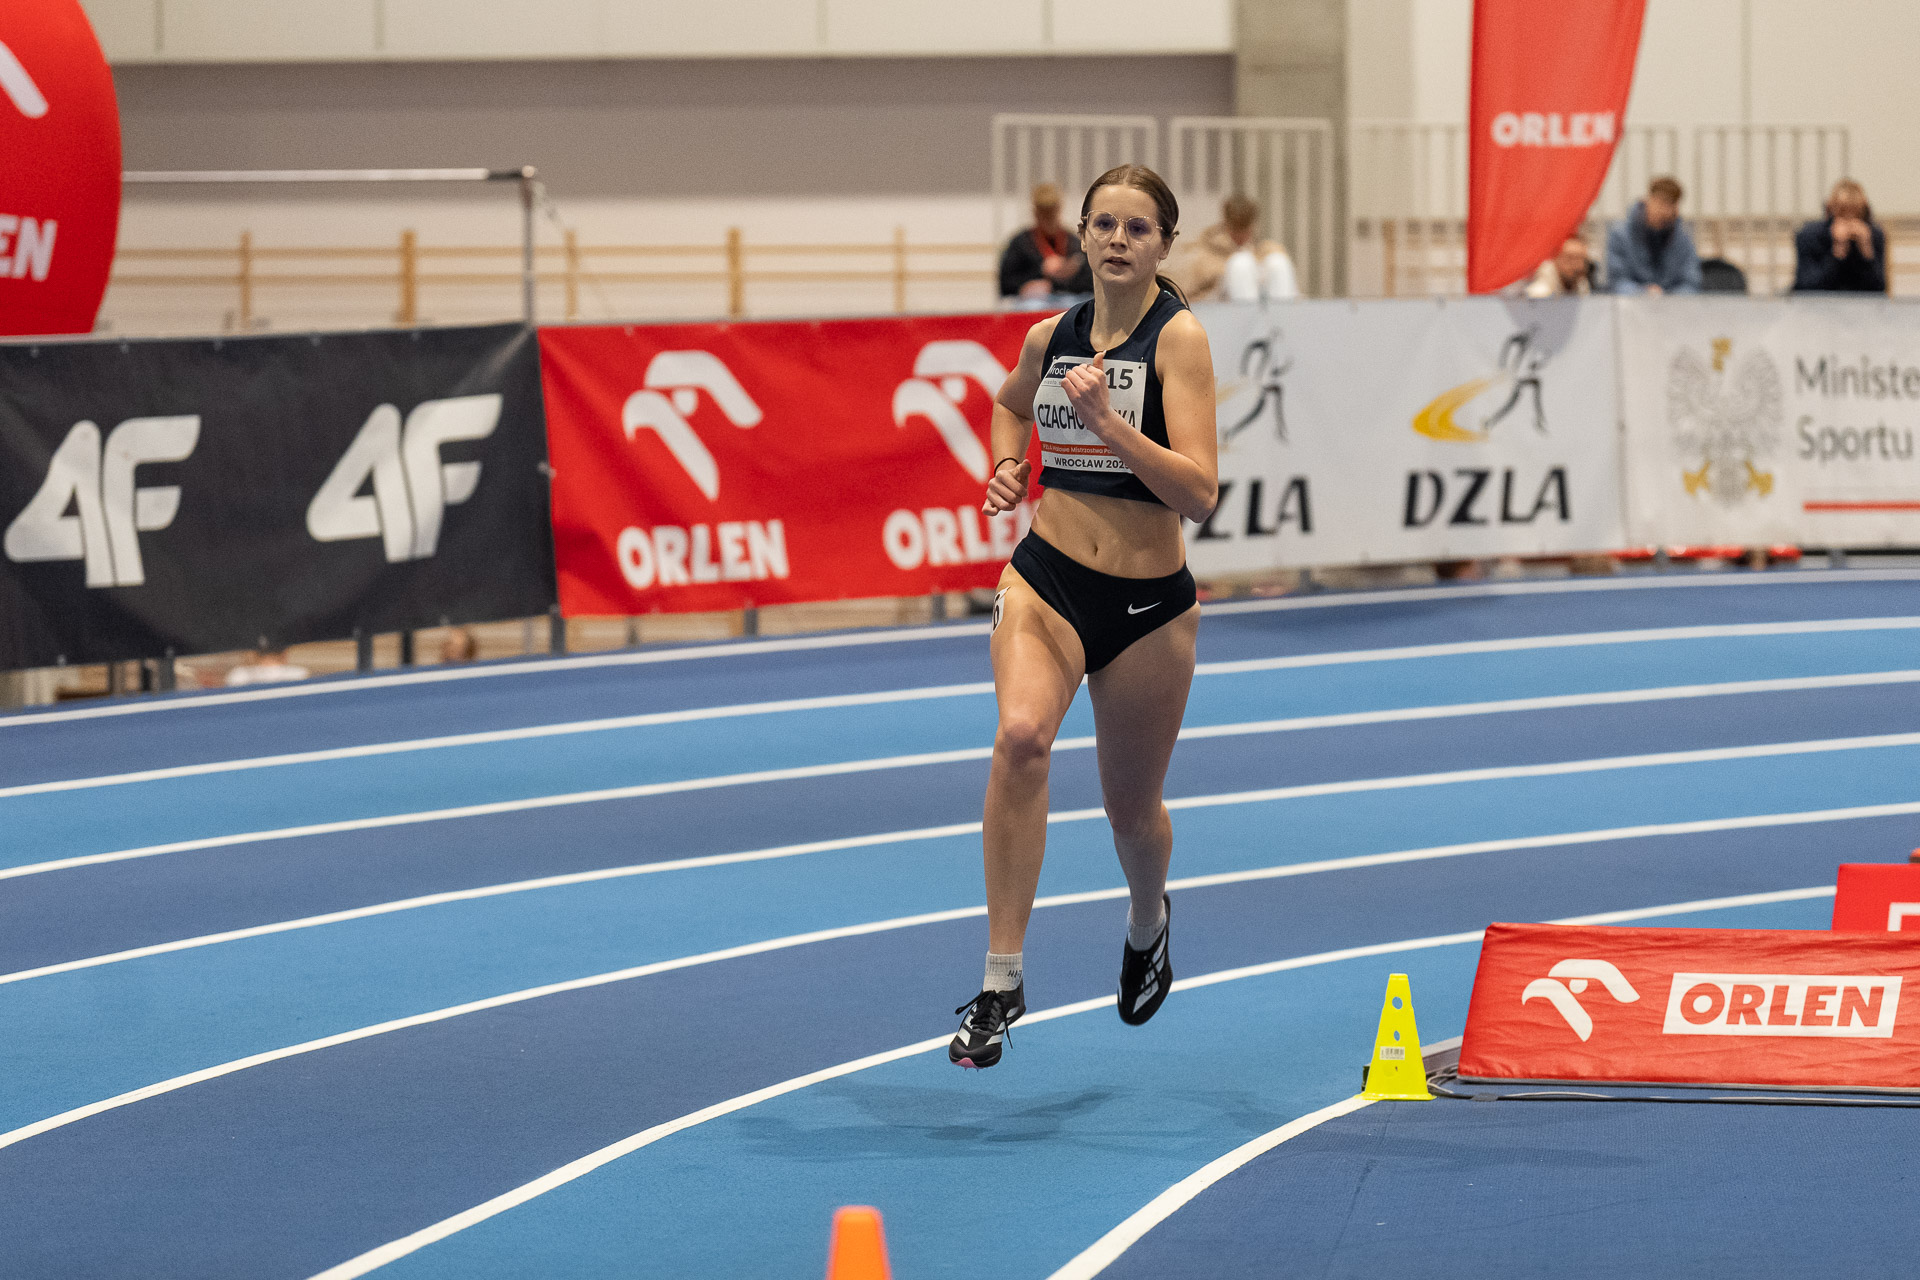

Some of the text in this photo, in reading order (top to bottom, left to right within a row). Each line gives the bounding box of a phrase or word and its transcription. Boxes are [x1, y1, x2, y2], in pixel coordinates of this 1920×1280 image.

[1491, 111, 1615, 147] ORLEN
[1795, 355, 1920, 400] Ministe
[1054, 457, 1104, 468] WROCŁAW
[1797, 415, 1914, 466] Sportu
[4, 415, 200, 588] 4F
[307, 394, 502, 562] 4F
[1403, 465, 1572, 529] DZLA
[1193, 476, 1313, 541] ZLA
[617, 518, 790, 590] ORLEN
[1680, 982, 1886, 1027] ORLEN
